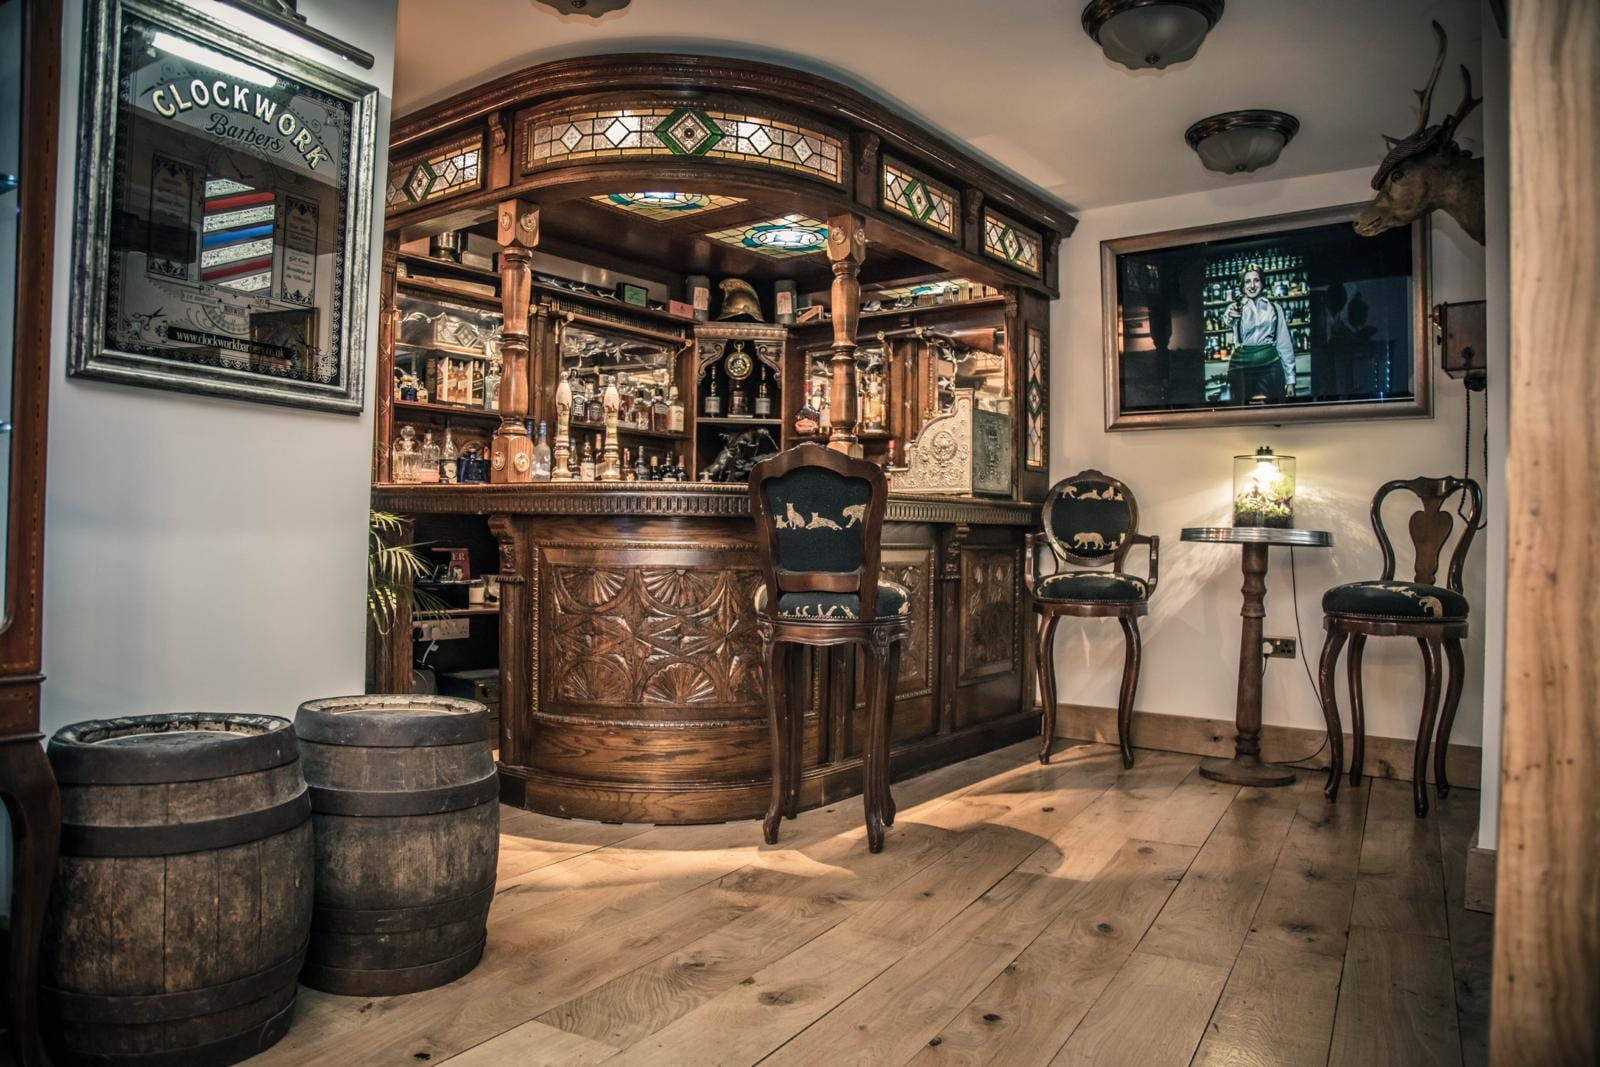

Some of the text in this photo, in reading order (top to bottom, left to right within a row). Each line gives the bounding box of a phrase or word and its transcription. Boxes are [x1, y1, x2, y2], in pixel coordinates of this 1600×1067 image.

[152, 79, 327, 169] CLOCKWORK
[205, 111, 284, 153] Barbers
[176, 331, 284, 359] www.clockworkbaruk
